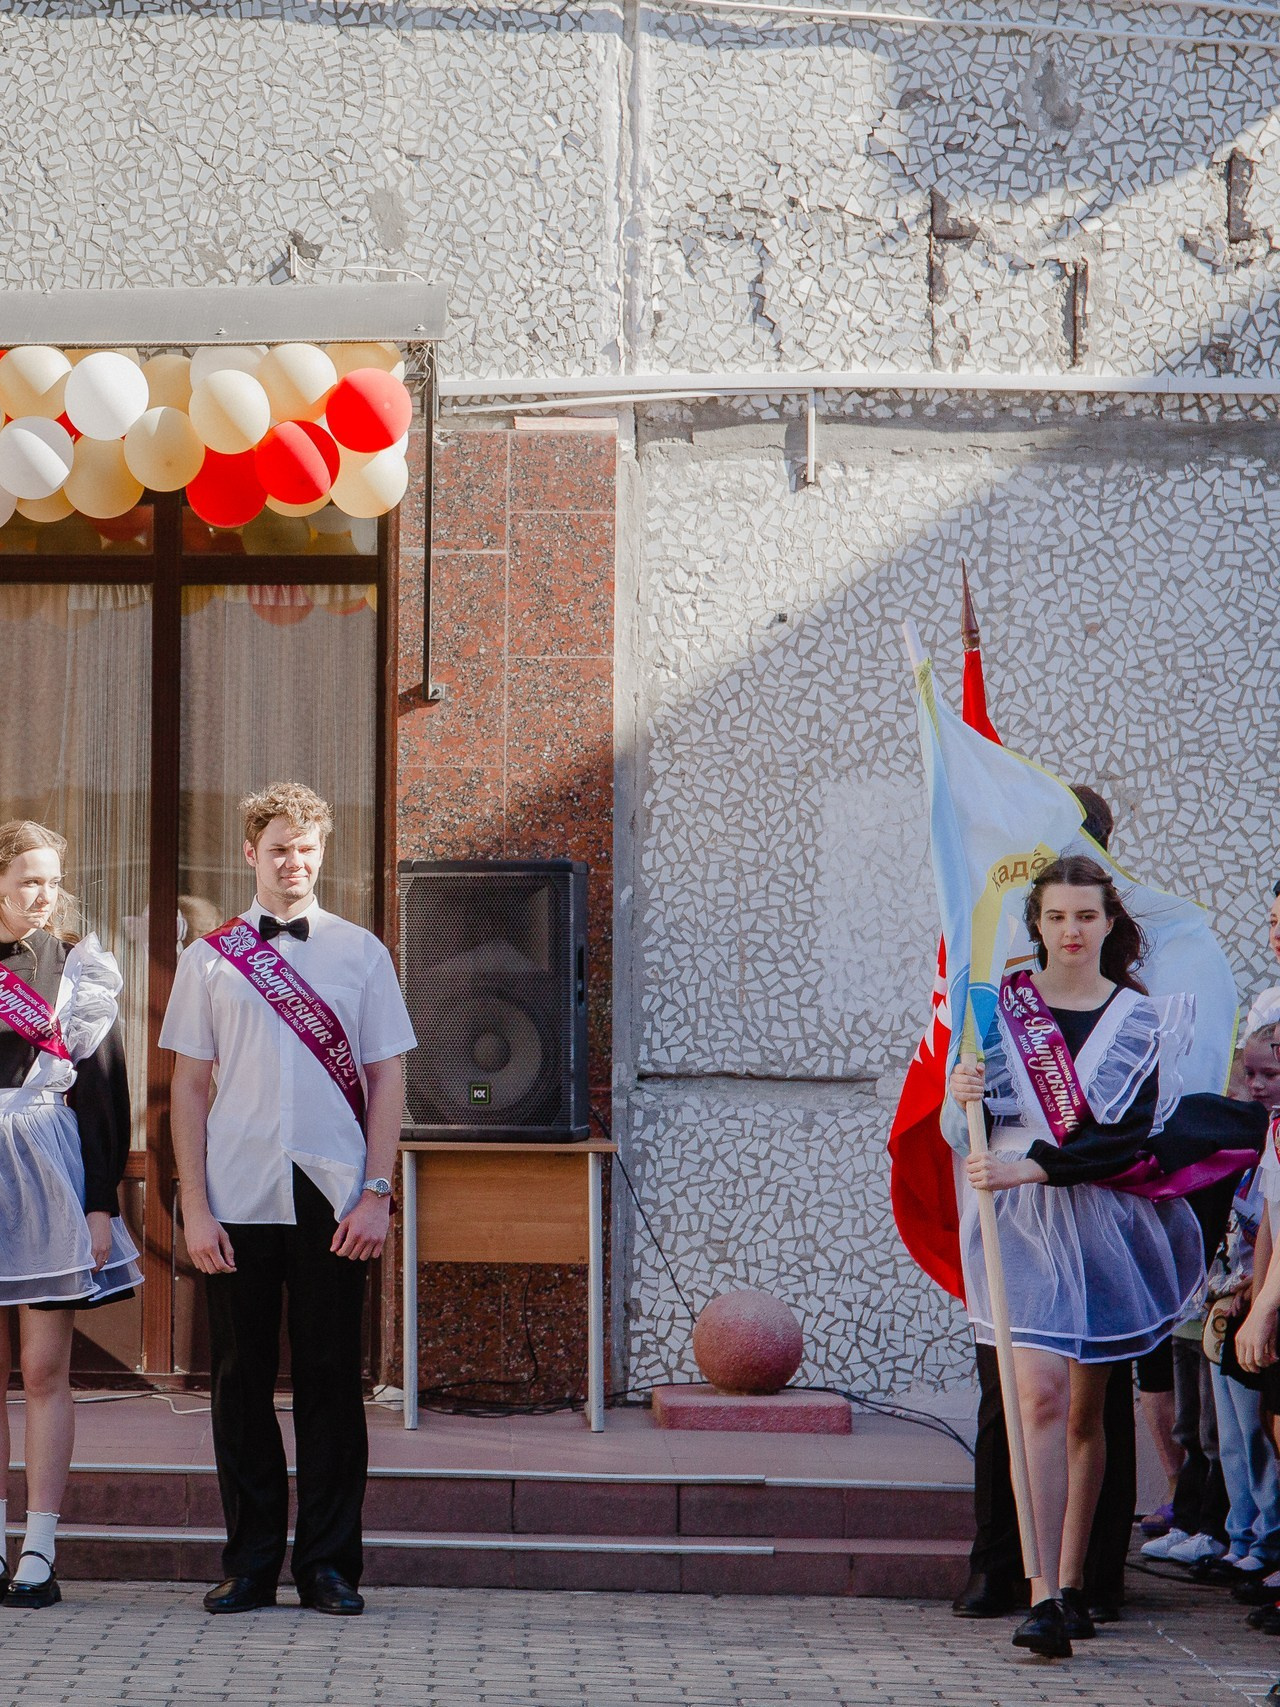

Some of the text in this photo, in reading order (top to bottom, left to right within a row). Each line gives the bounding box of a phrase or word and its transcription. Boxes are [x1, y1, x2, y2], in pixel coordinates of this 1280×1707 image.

[8, 1013, 25, 1028] СОШ
[247, 950, 333, 1045] Выпускник
[249, 972, 269, 990] МАОУ
[277, 1002, 295, 1021] СОШ
[1018, 1034, 1033, 1055] МАОУ
[1035, 1074, 1049, 1094] СОШ
[474, 1090, 486, 1098] KX
